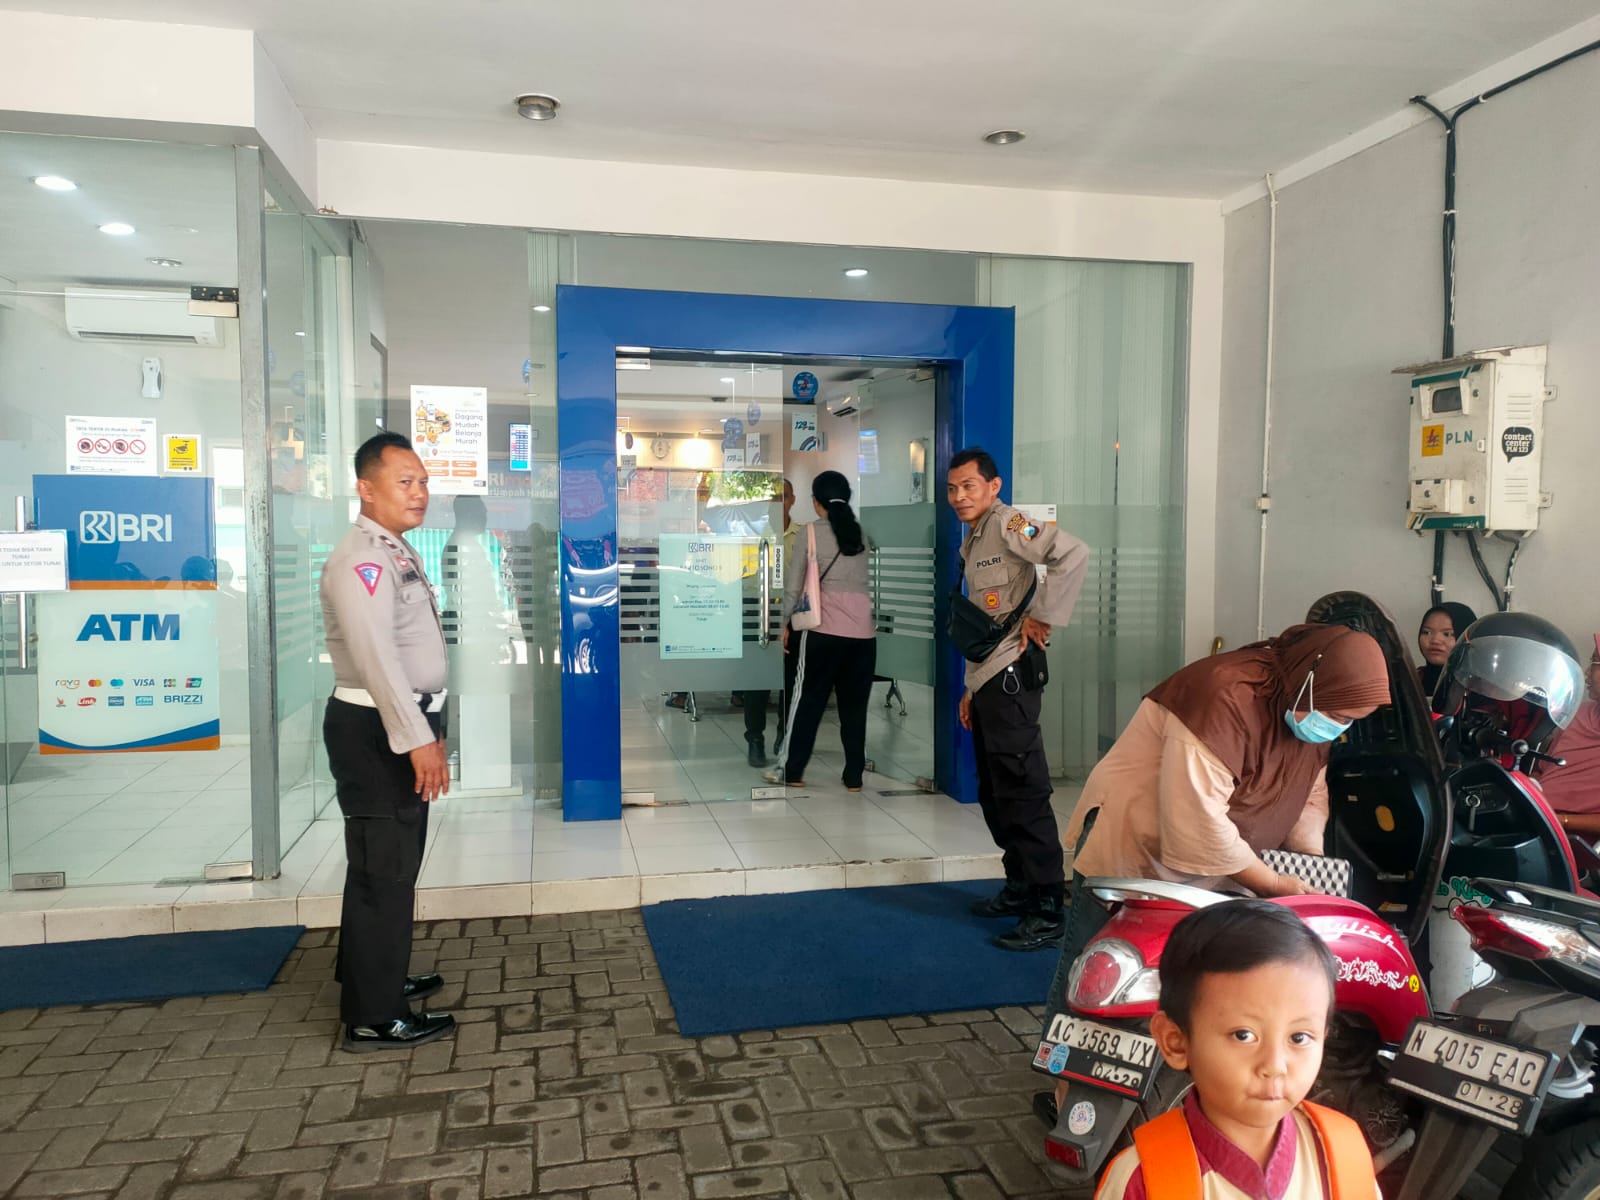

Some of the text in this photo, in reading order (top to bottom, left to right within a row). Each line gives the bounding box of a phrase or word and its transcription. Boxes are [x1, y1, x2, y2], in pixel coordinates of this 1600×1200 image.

[455, 413, 483, 422] Dagang
[1445, 430, 1473, 445] PLN
[118, 514, 172, 542] BRI
[699, 544, 714, 552] BRI
[976, 556, 1001, 568] POLRI
[76, 614, 180, 641] ATM
[133, 678, 155, 687] VISA
[164, 695, 203, 704] BRIZZI
[1051, 1019, 1153, 1067] AC 3569 VX
[1411, 1029, 1537, 1087] N 4015 EAC
